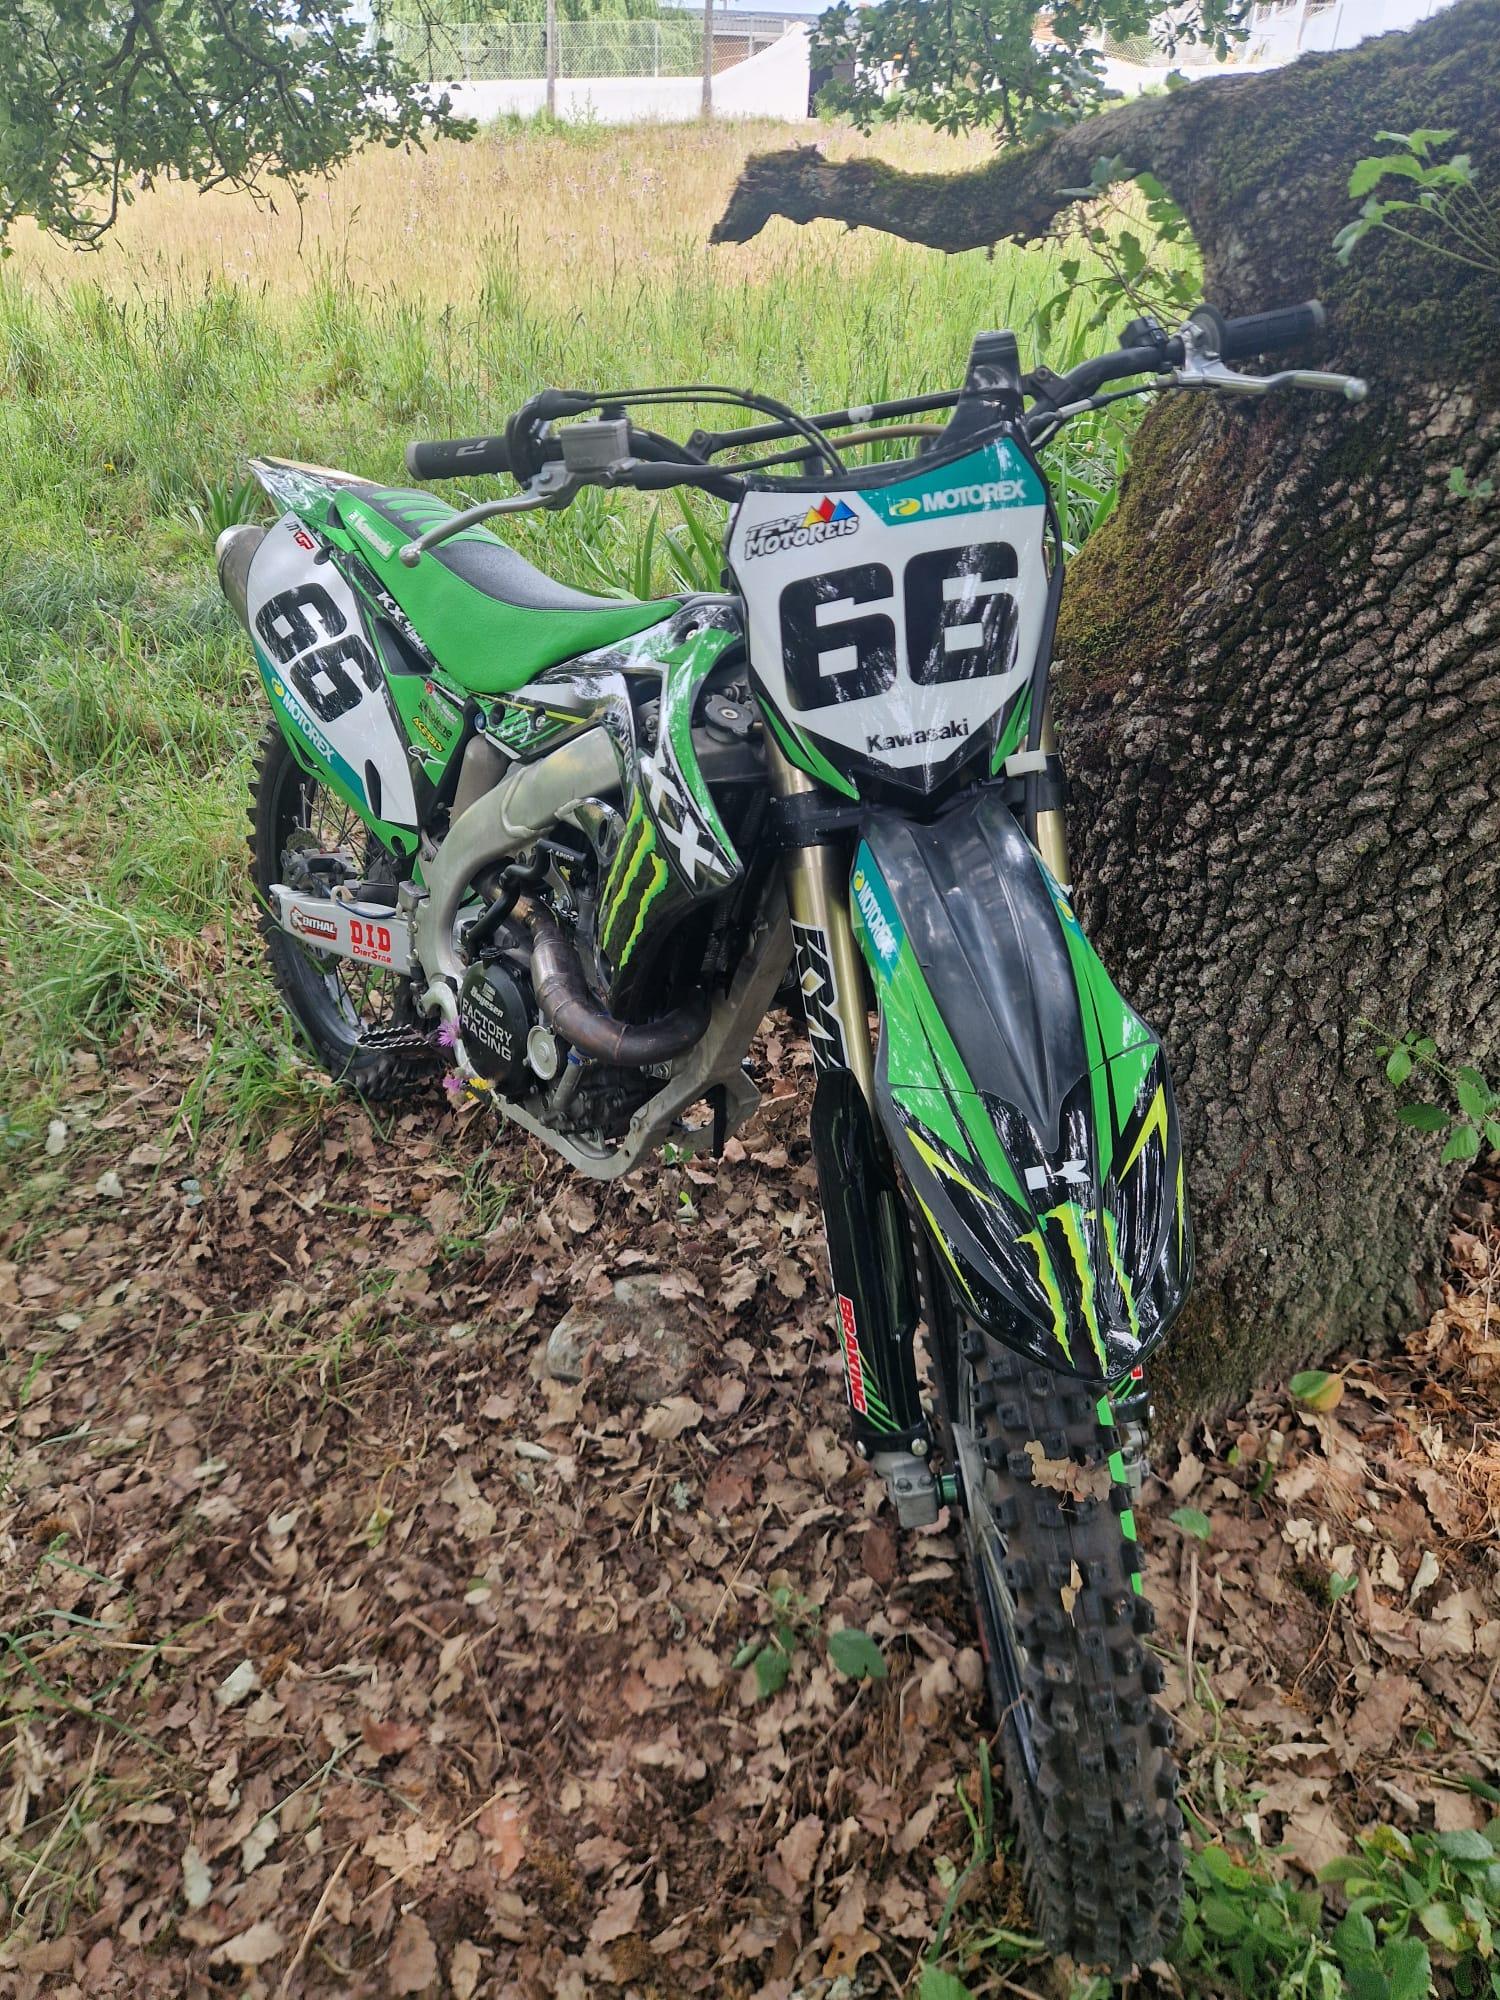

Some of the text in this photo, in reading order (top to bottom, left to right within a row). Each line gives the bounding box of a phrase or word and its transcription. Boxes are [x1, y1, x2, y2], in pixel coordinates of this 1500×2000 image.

[921, 478, 1027, 514] MOTOREX
[779, 541, 1019, 712] 66
[282, 690, 336, 765] MOTOREX
[865, 717, 970, 754] Kawasaki
[461, 1012, 513, 1062] RACING
[462, 996, 513, 1047] FACTORY
[839, 1294, 868, 1415] BRAKING
